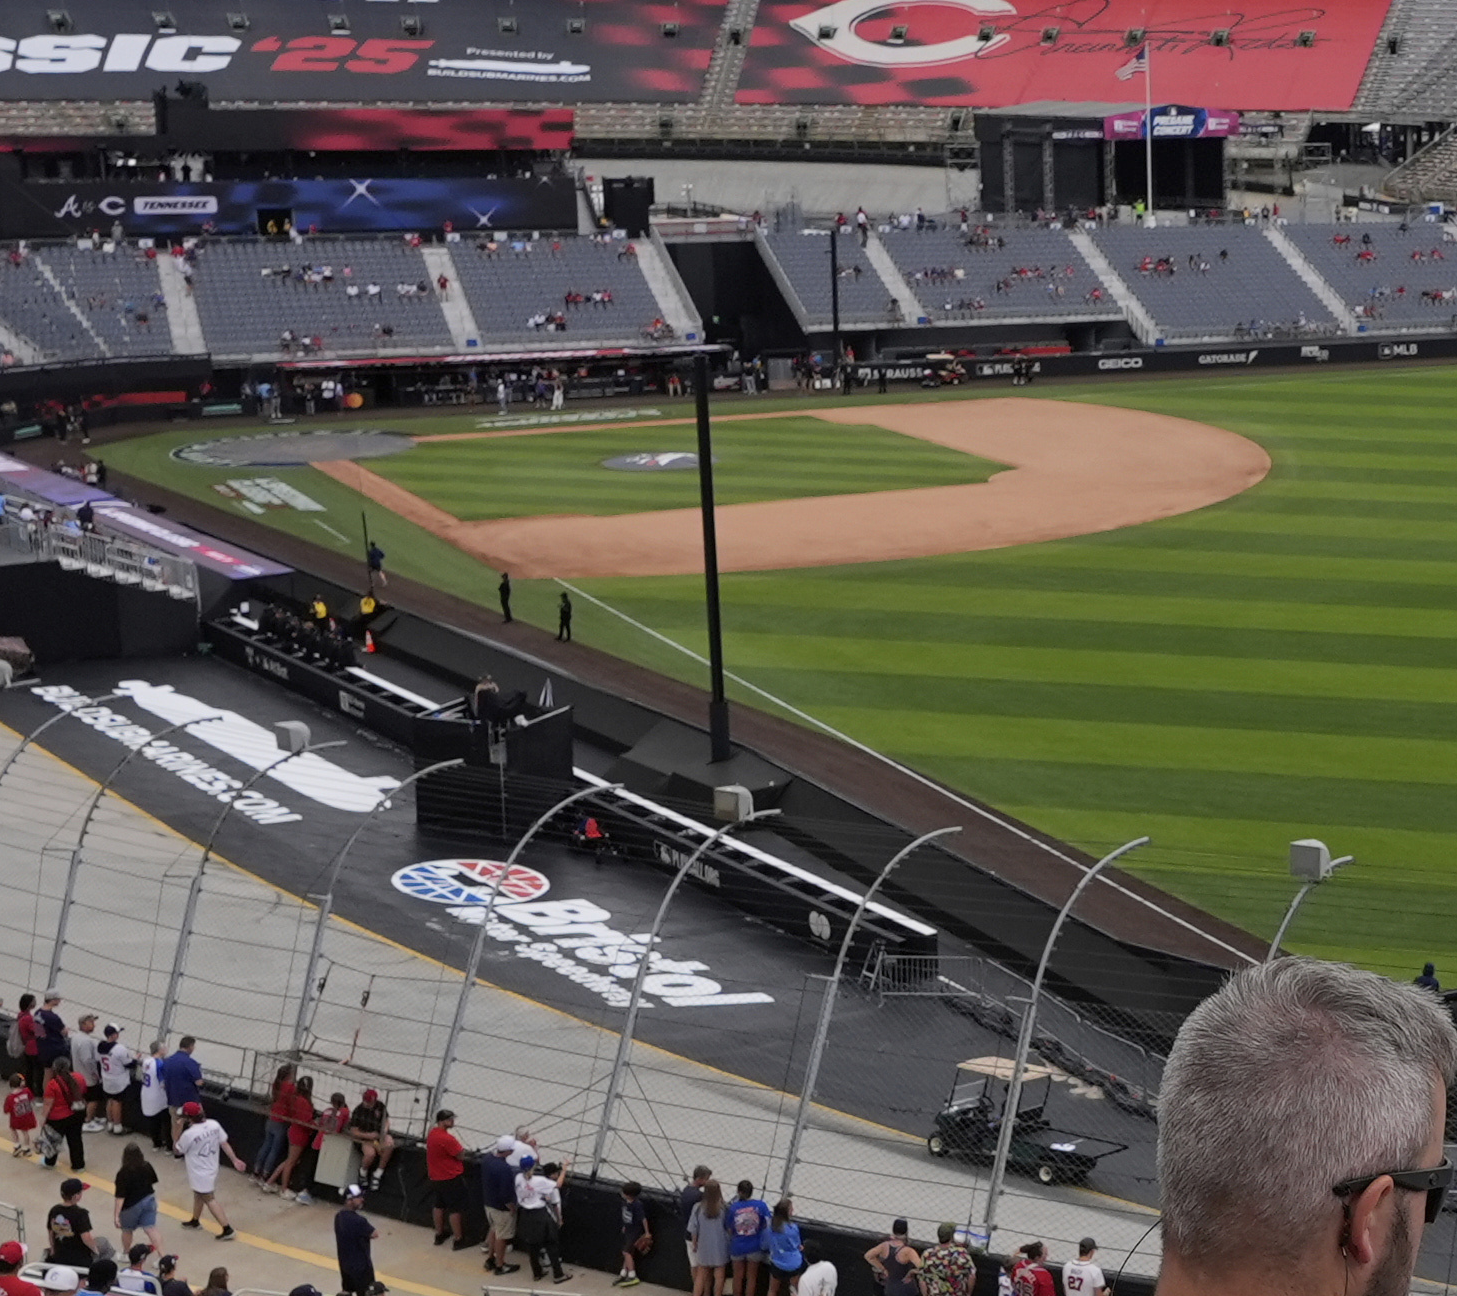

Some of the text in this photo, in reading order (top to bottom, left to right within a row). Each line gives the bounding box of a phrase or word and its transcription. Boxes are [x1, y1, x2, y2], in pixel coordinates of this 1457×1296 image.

[251, 36, 435, 74] '25
[466, 47, 554, 61] Presented by
[427, 68, 591, 83] BUILDSUBMARINES.COM
[142, 199, 212, 212] TENNESSEE
[1393, 344, 1418, 355] MLB
[1098, 357, 1143, 369] GEICO
[1199, 352, 1247, 364] GATORADE
[488, 898, 775, 1007] Bristol
[1067, 1275, 1083, 1291] 27
